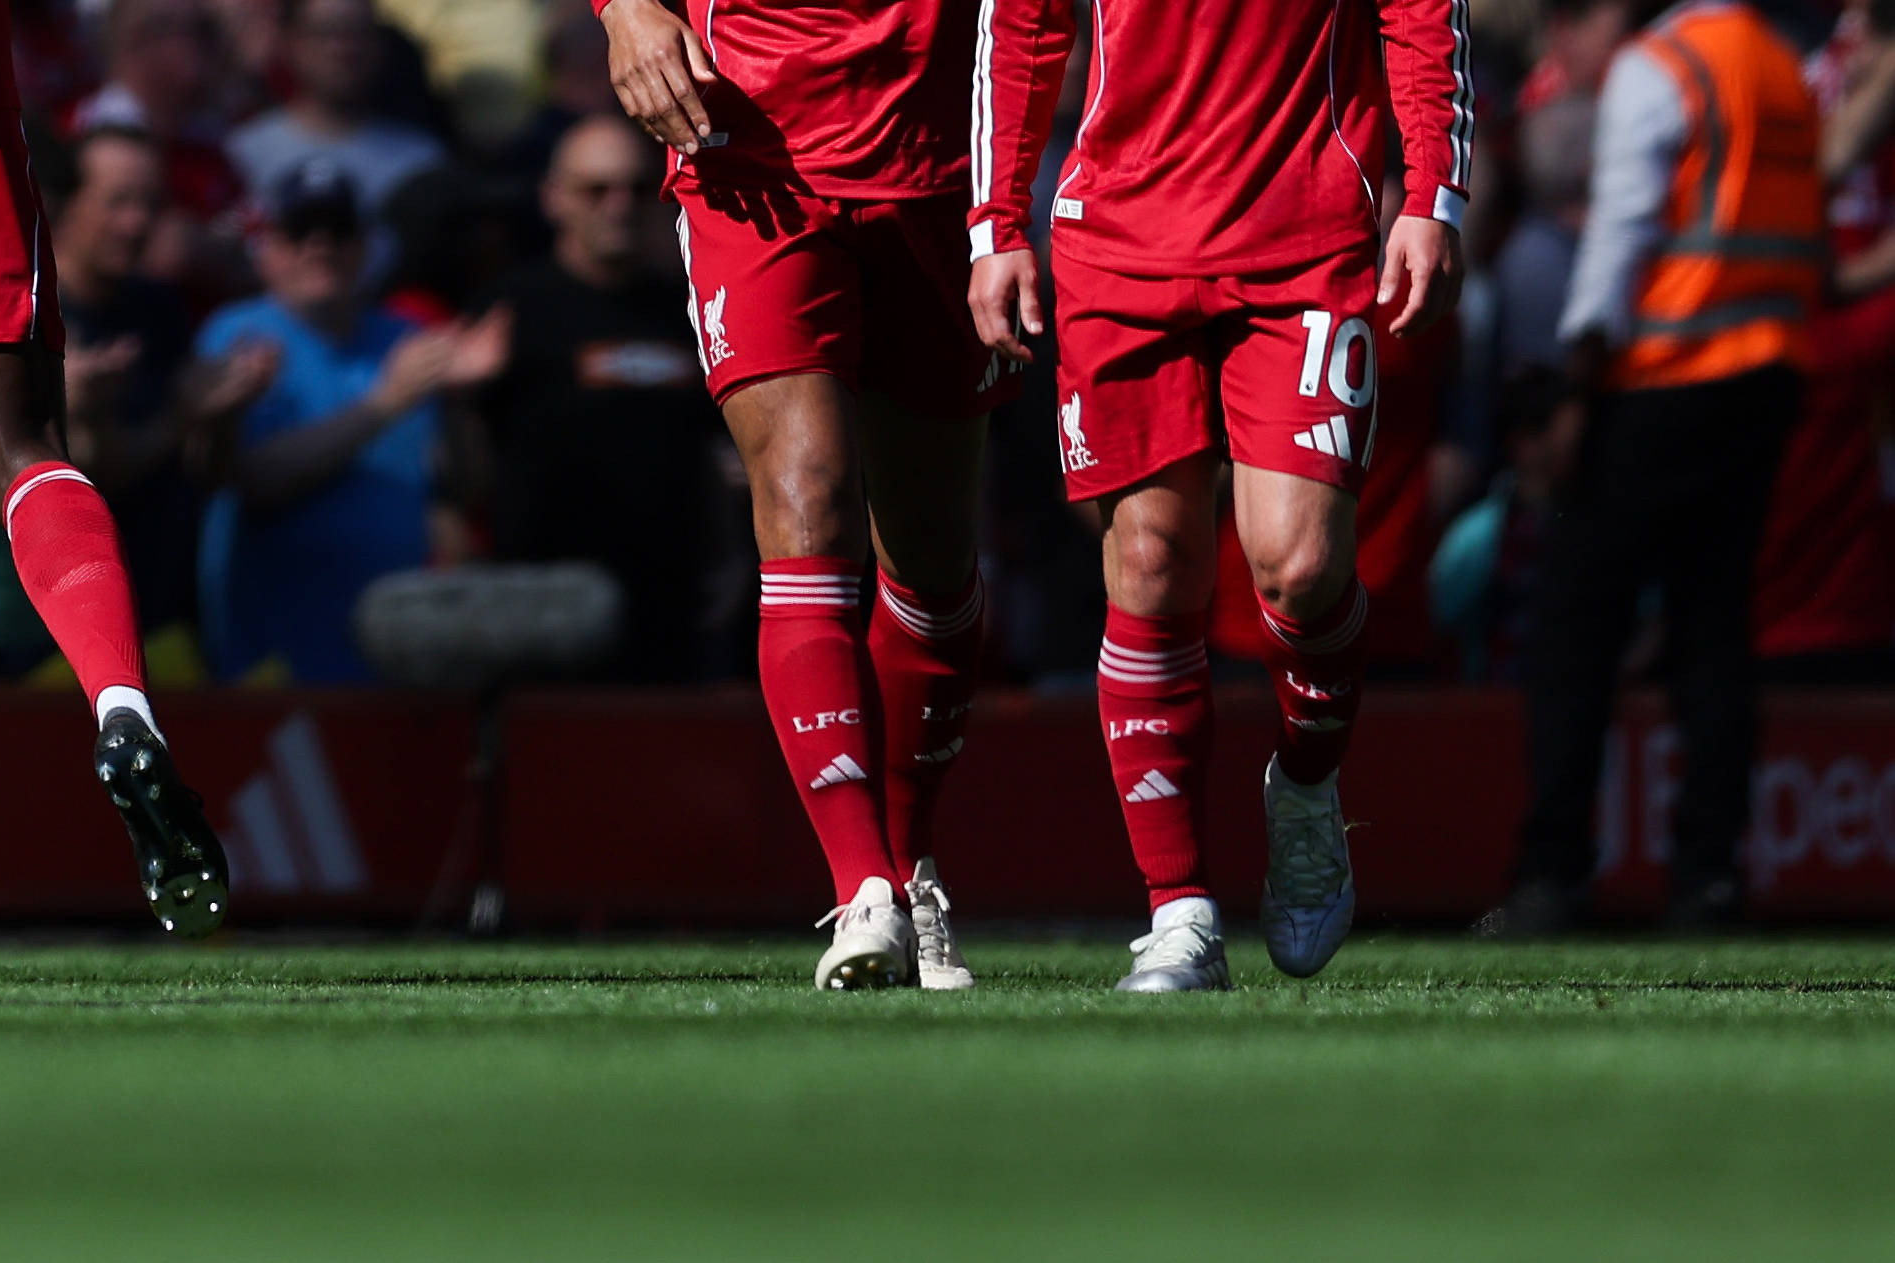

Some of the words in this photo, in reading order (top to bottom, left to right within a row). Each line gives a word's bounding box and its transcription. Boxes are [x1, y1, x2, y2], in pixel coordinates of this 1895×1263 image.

[1298, 310, 1375, 408] 10
[792, 708, 861, 734] LFC
[1109, 718, 1170, 741] LFC
